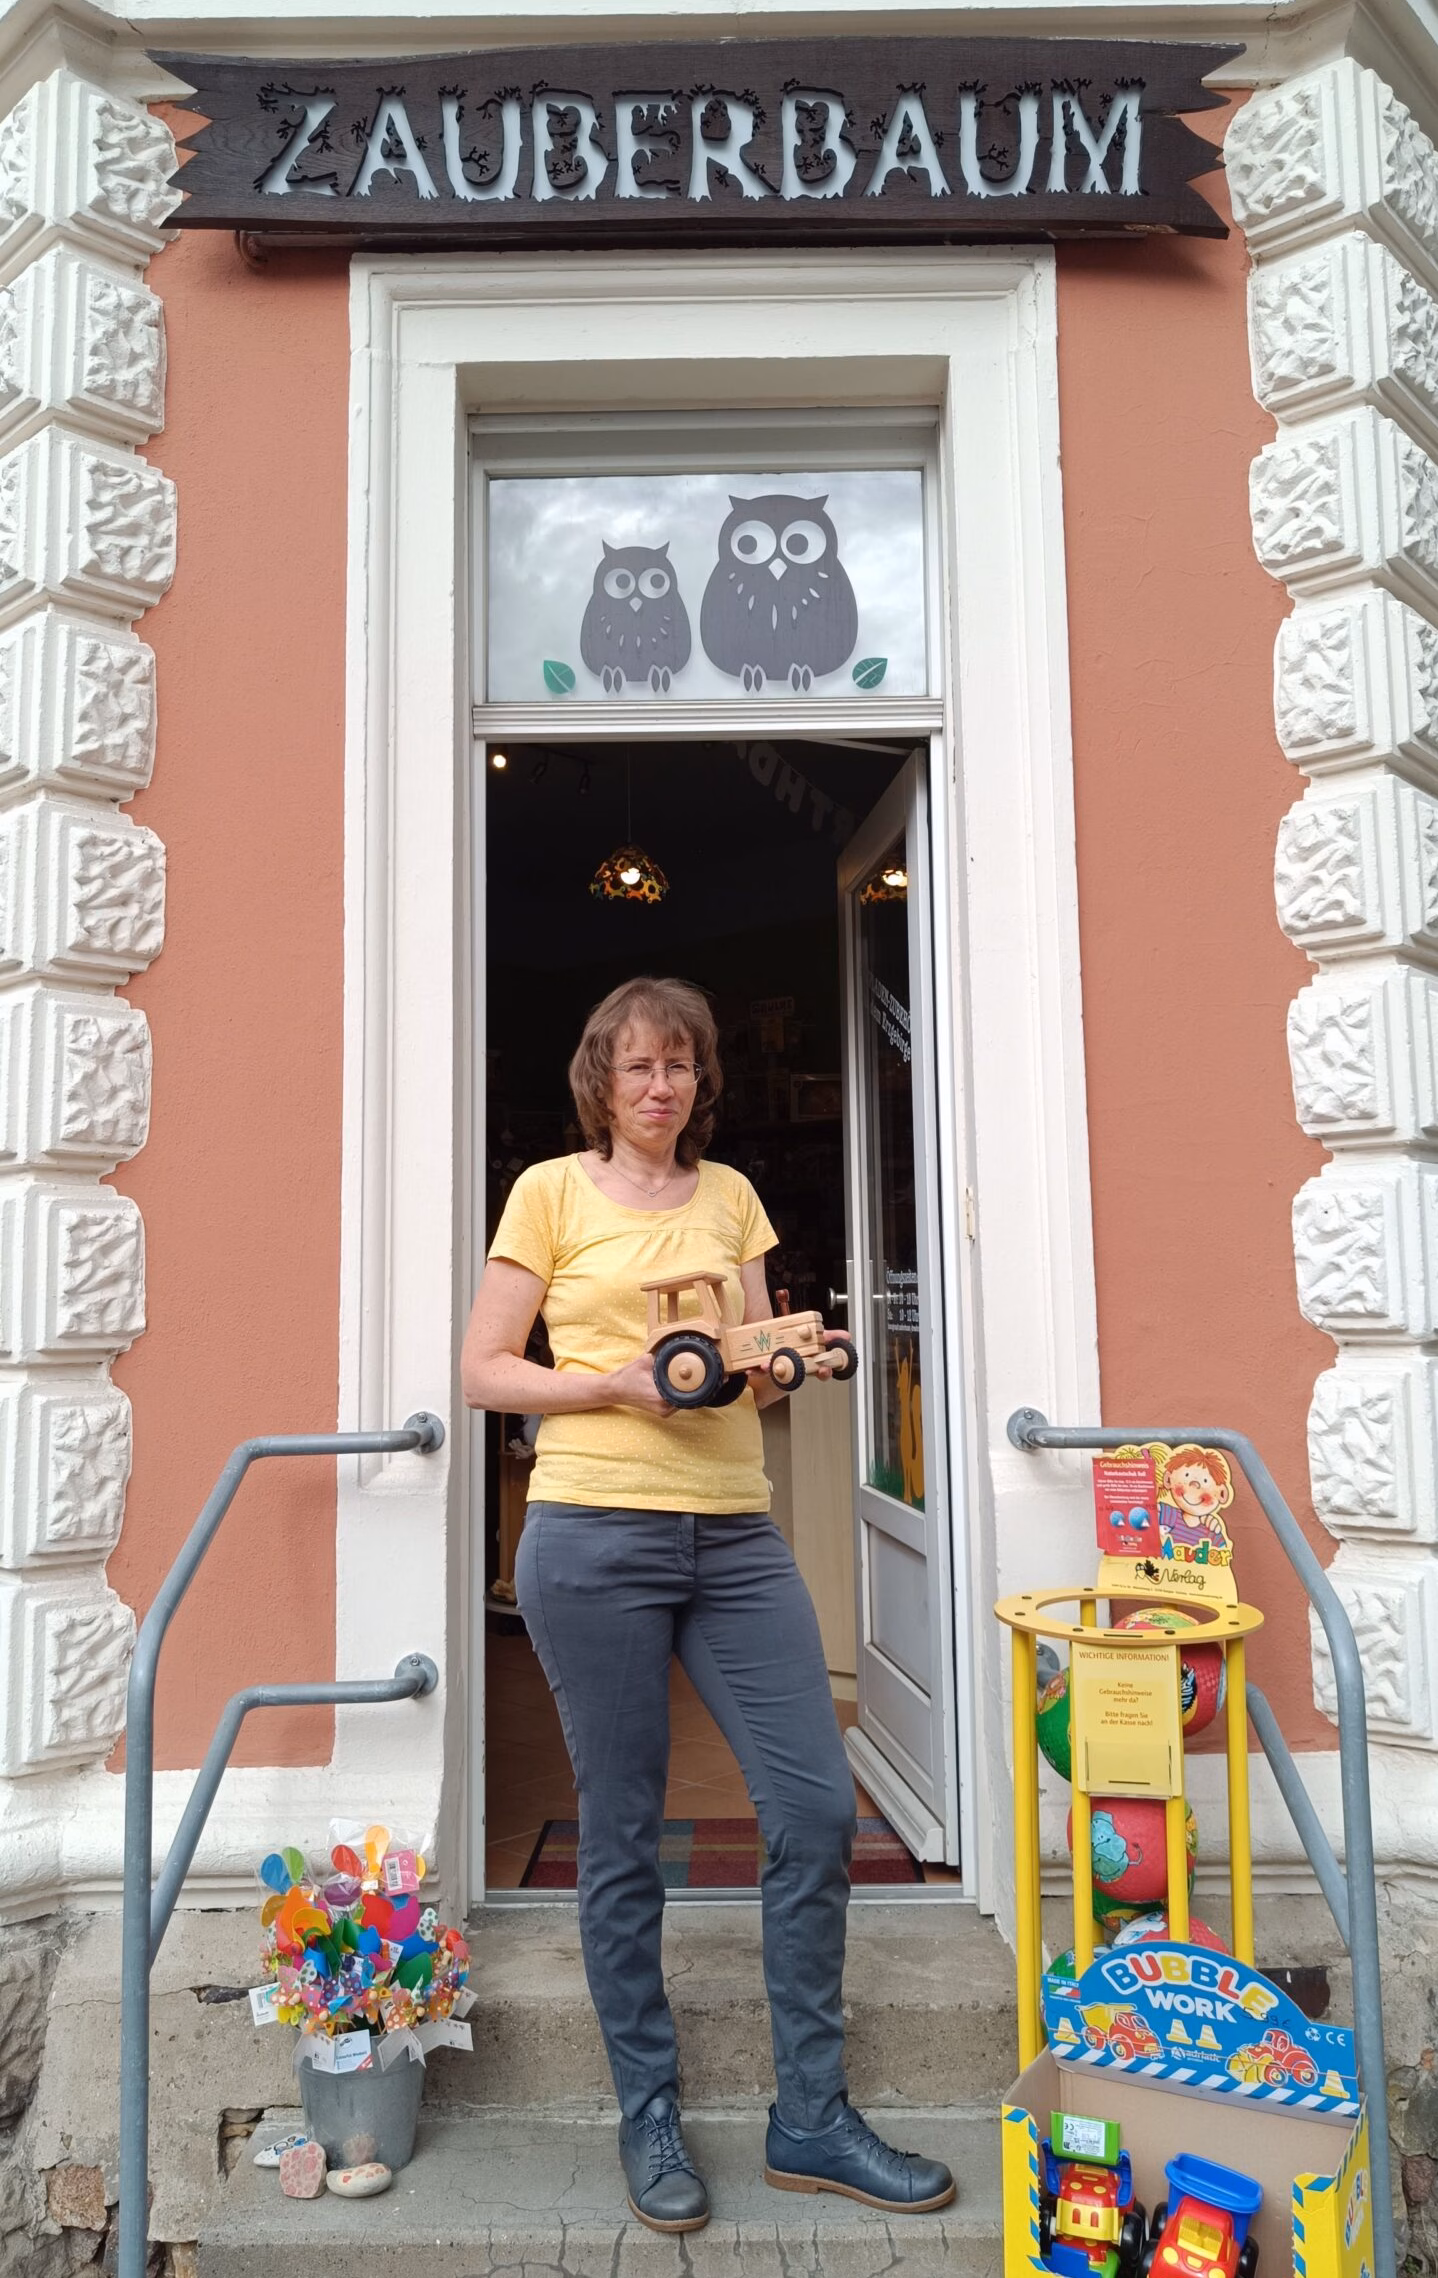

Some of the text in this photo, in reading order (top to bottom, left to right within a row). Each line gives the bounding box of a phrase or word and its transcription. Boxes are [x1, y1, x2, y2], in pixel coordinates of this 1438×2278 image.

[254, 79, 1148, 201] ZAUBERBAUM
[1079, 1651, 1169, 1662] WICHTIGE INFORMATION!
[1098, 1688, 1152, 1697] Gebrauchshinweise
[1120, 1711, 1139, 1720] fragen
[1140, 1711, 1149, 1719] Sie
[1109, 1718, 1119, 1726] der
[1120, 1718, 1136, 1726] Kasse
[1137, 1719, 1153, 1727] nach!
[1105, 1953, 1277, 2021] BUBBLE
[1145, 1989, 1237, 2023] WORK
